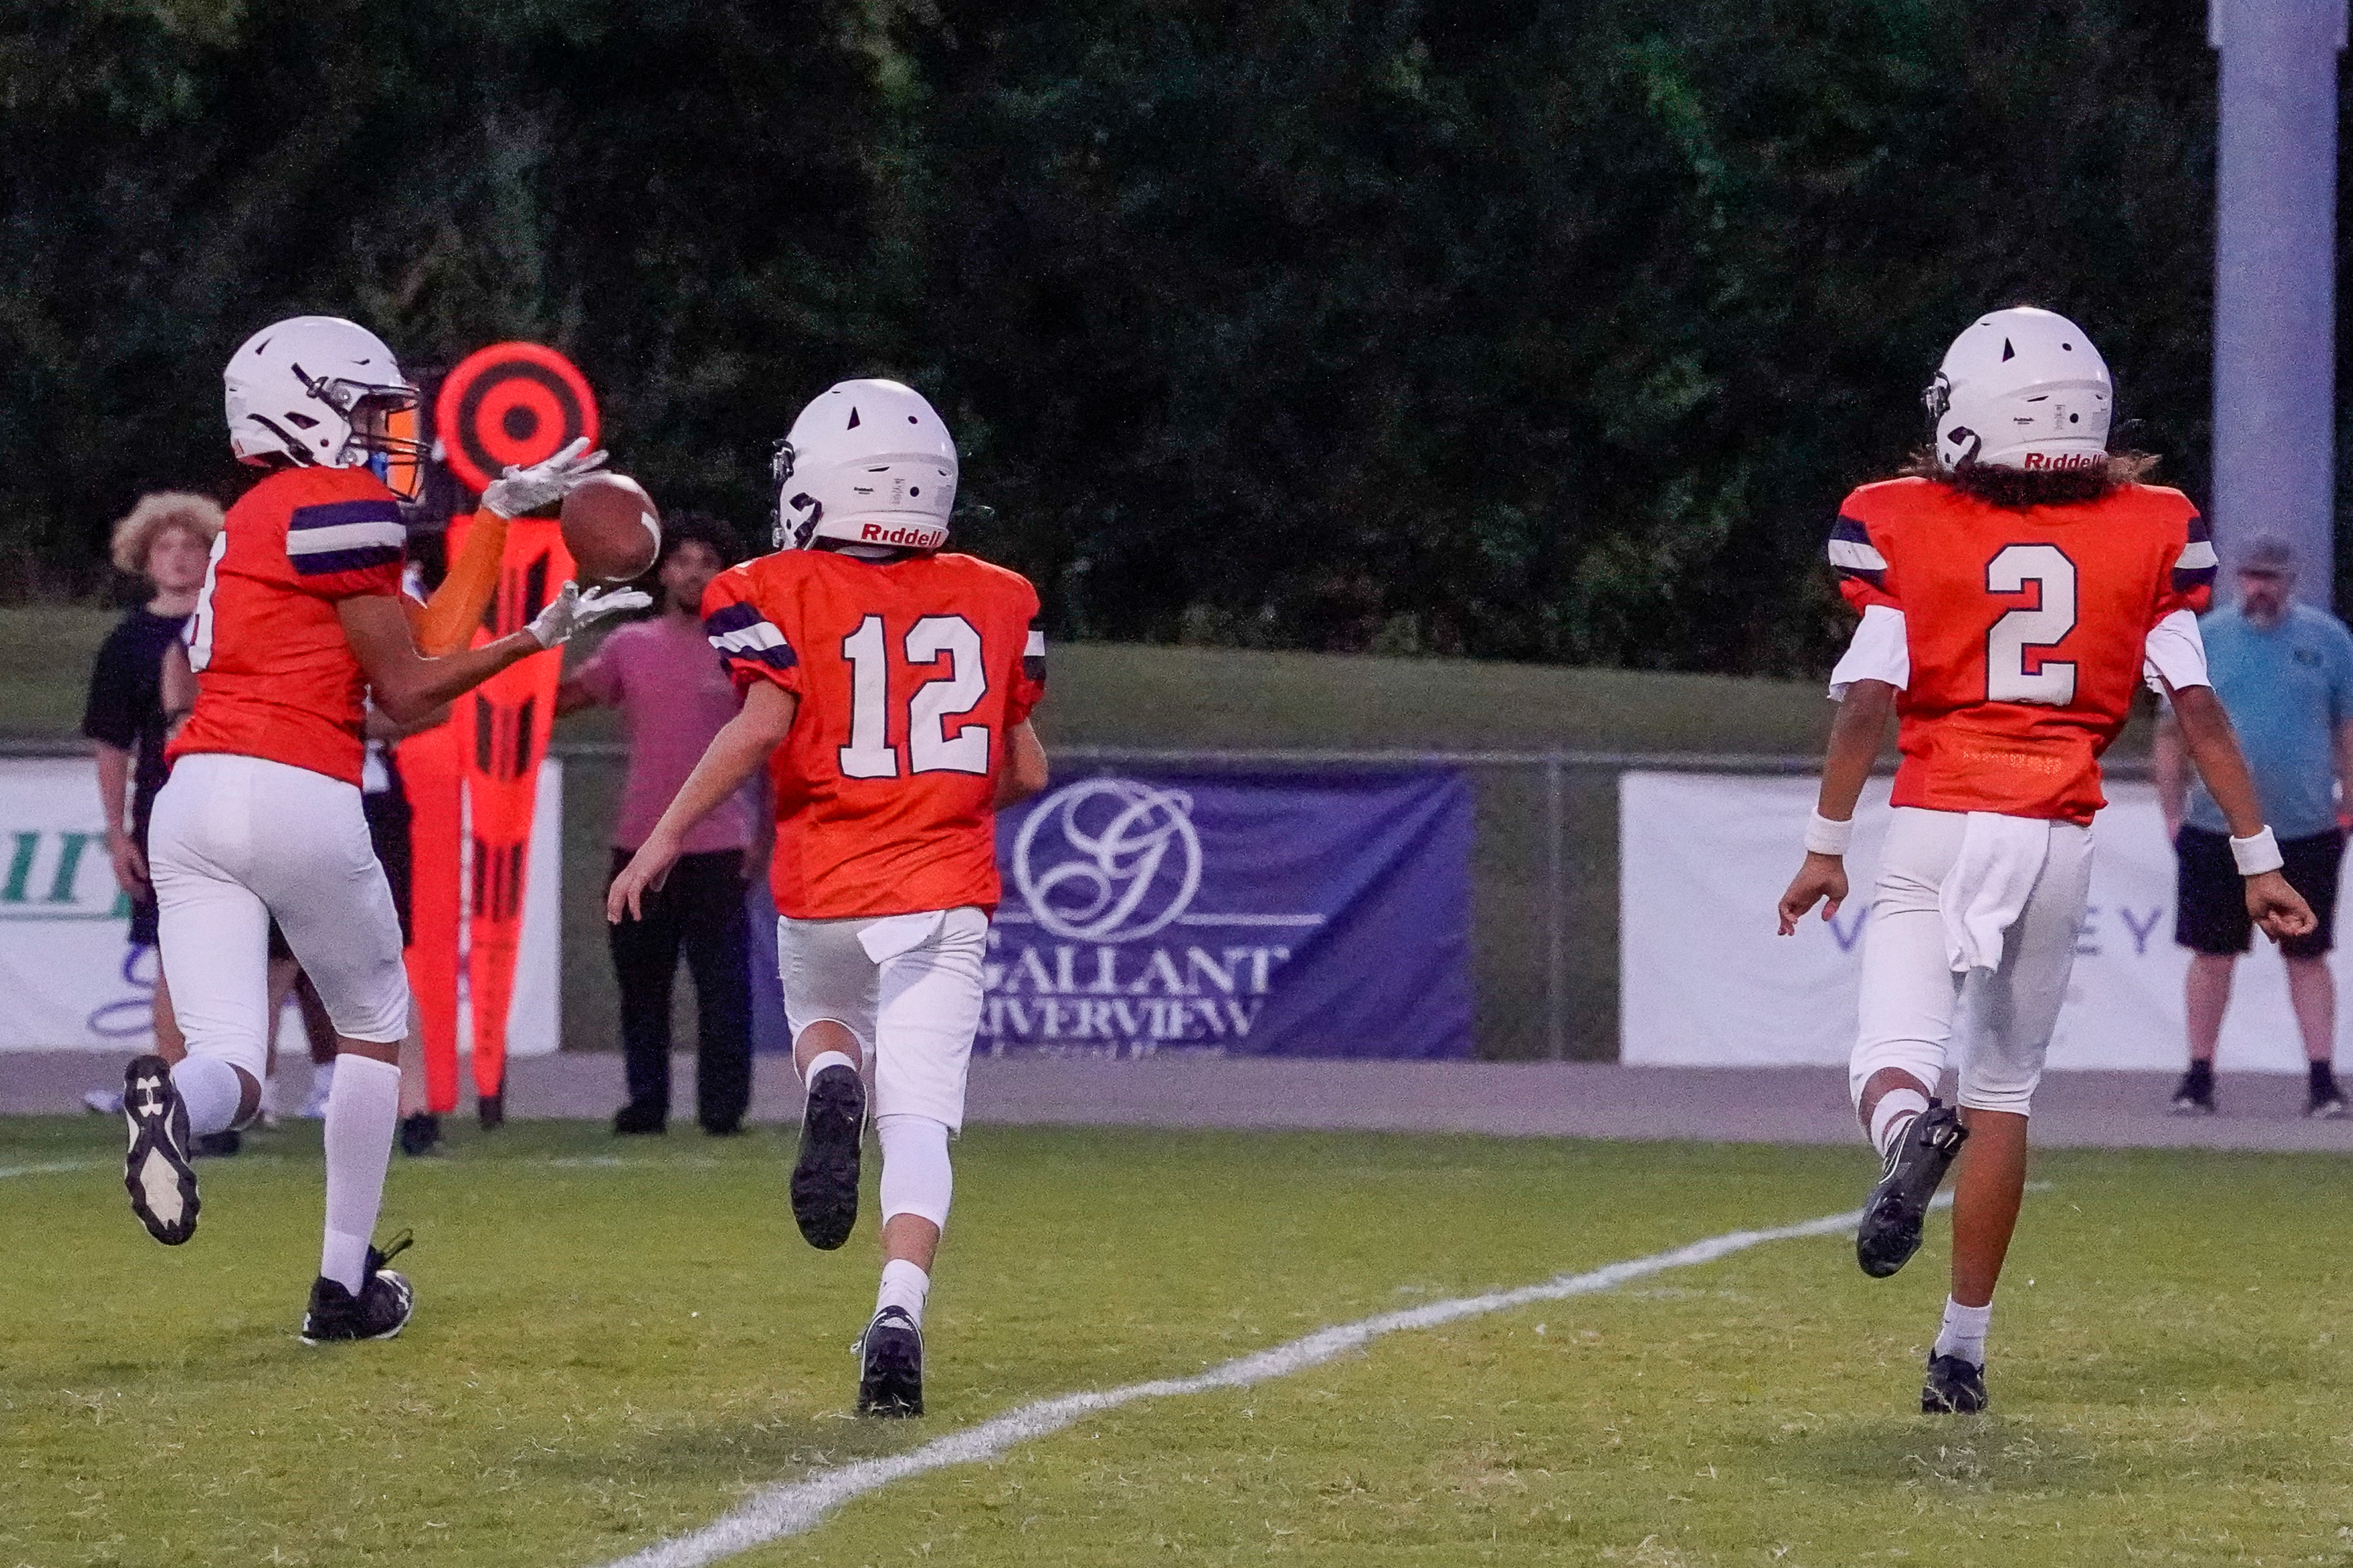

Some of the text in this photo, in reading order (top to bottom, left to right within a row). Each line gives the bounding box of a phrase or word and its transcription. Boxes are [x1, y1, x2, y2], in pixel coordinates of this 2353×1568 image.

[2025, 453, 2102, 470] Riddell
[862, 523, 942, 546] Riddell
[1986, 543, 2077, 707] 2
[838, 614, 990, 778] 12
